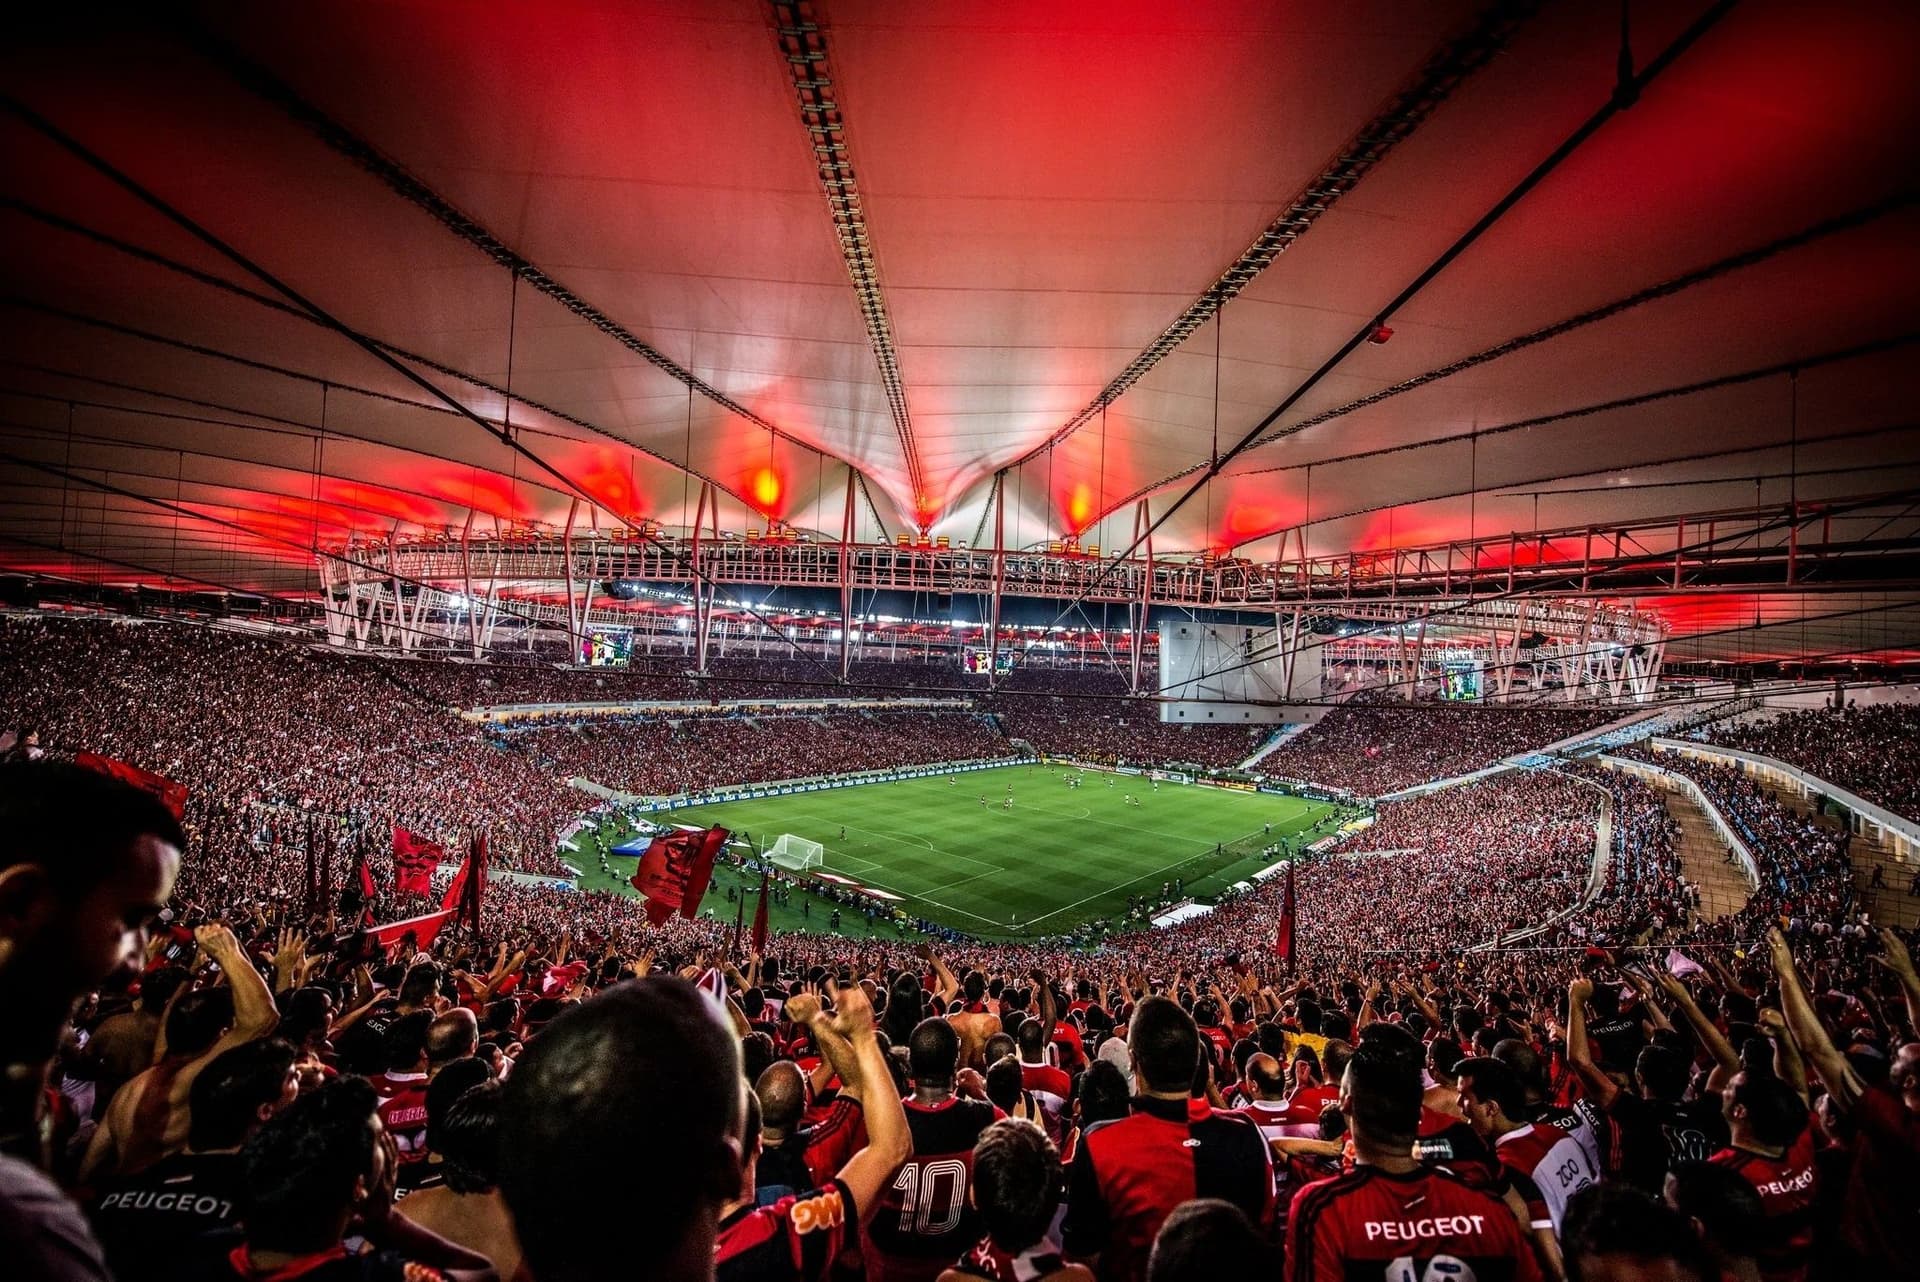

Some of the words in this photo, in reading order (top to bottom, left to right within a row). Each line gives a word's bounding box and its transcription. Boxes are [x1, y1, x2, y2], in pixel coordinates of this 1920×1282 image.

[746, 860, 759, 870] VISA
[761, 865, 775, 875] VISA
[1756, 1166, 1813, 1197] PEUGEO
[99, 1191, 233, 1218] PEUGEOT
[893, 1159, 966, 1235] 10
[1364, 1215, 1484, 1240] PEUGEOT
